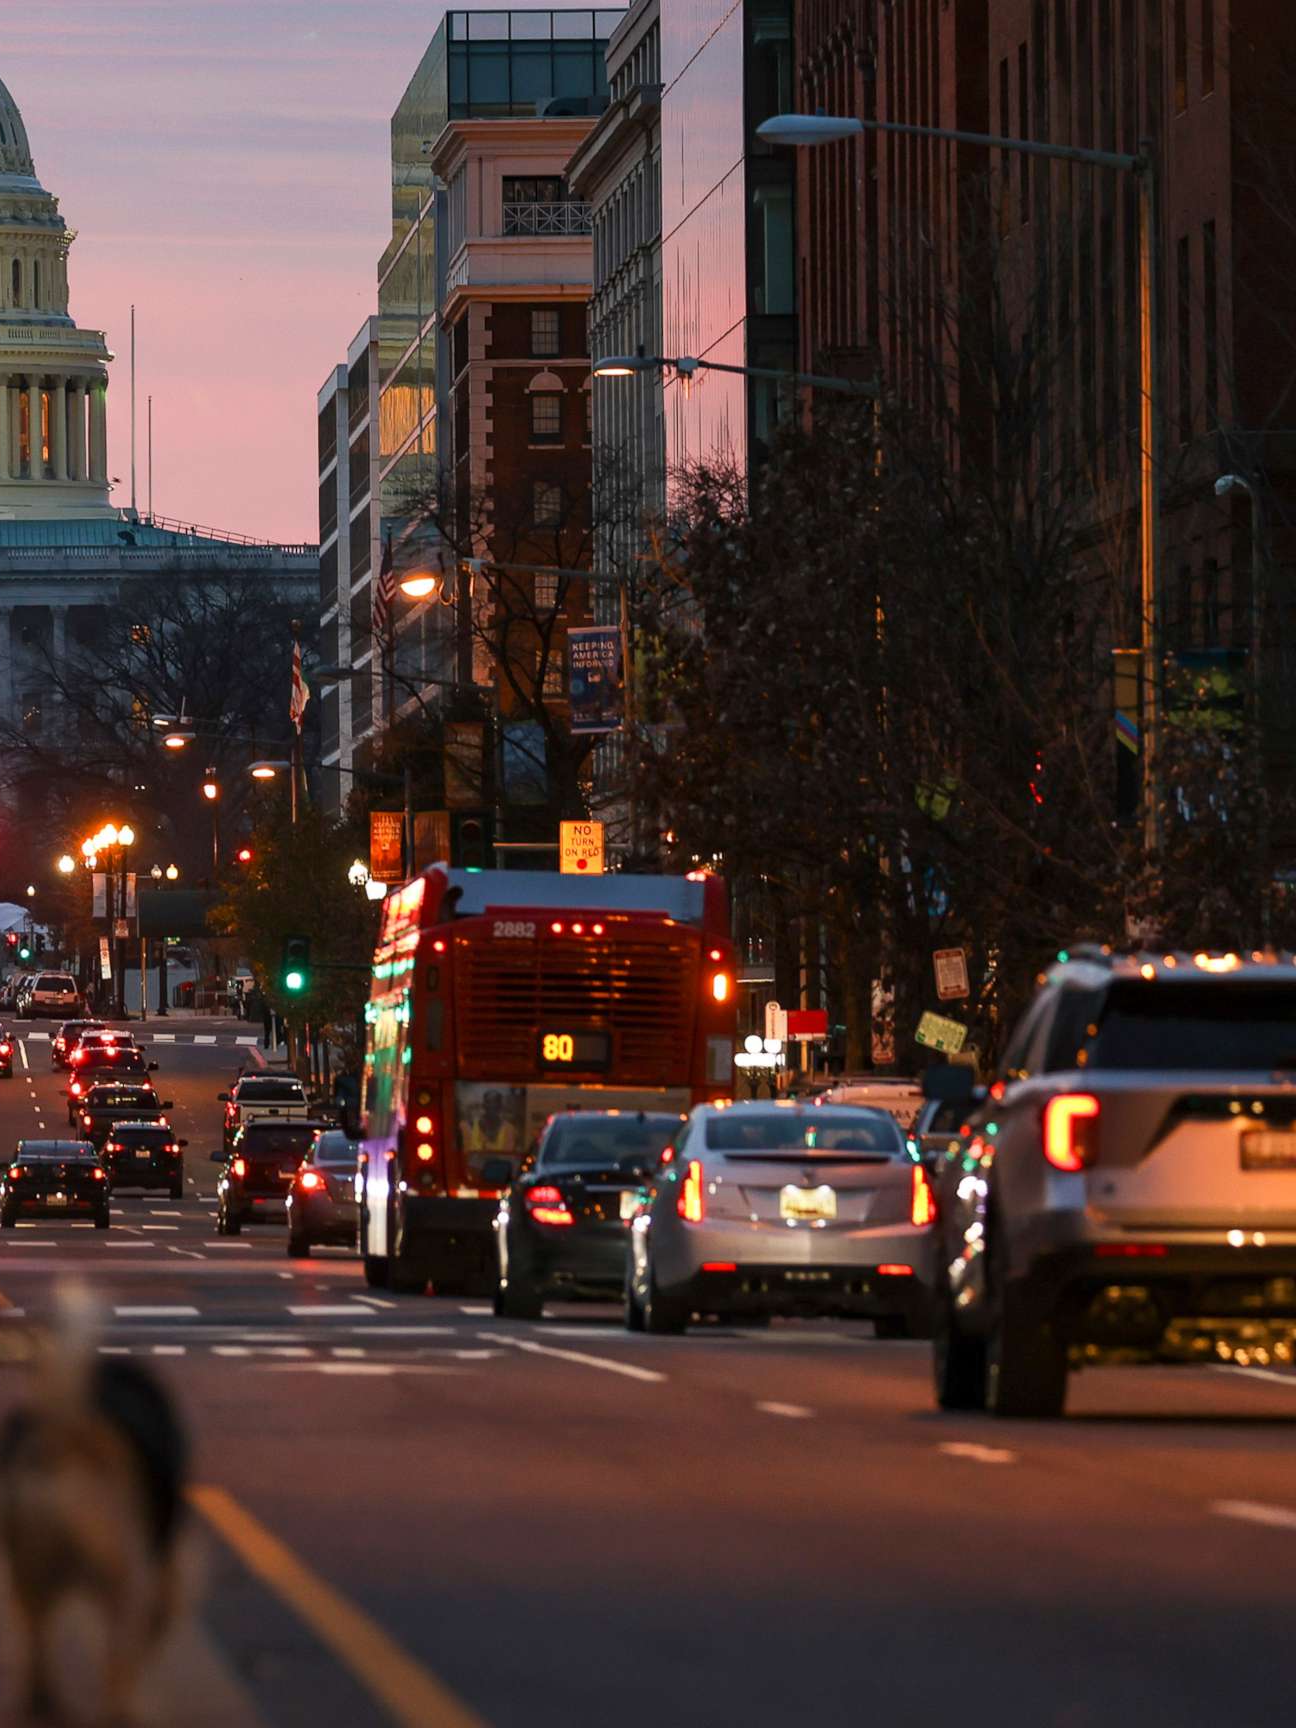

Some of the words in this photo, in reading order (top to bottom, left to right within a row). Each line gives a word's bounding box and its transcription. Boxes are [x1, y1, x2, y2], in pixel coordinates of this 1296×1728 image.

[572, 641, 614, 651] KEEPNG
[572, 650, 614, 660] AMERCA
[572, 659, 614, 669] INFORMD
[574, 825, 592, 836] NO
[571, 838, 594, 846] TURN
[565, 848, 578, 857] ON
[543, 1033, 573, 1062] 80
